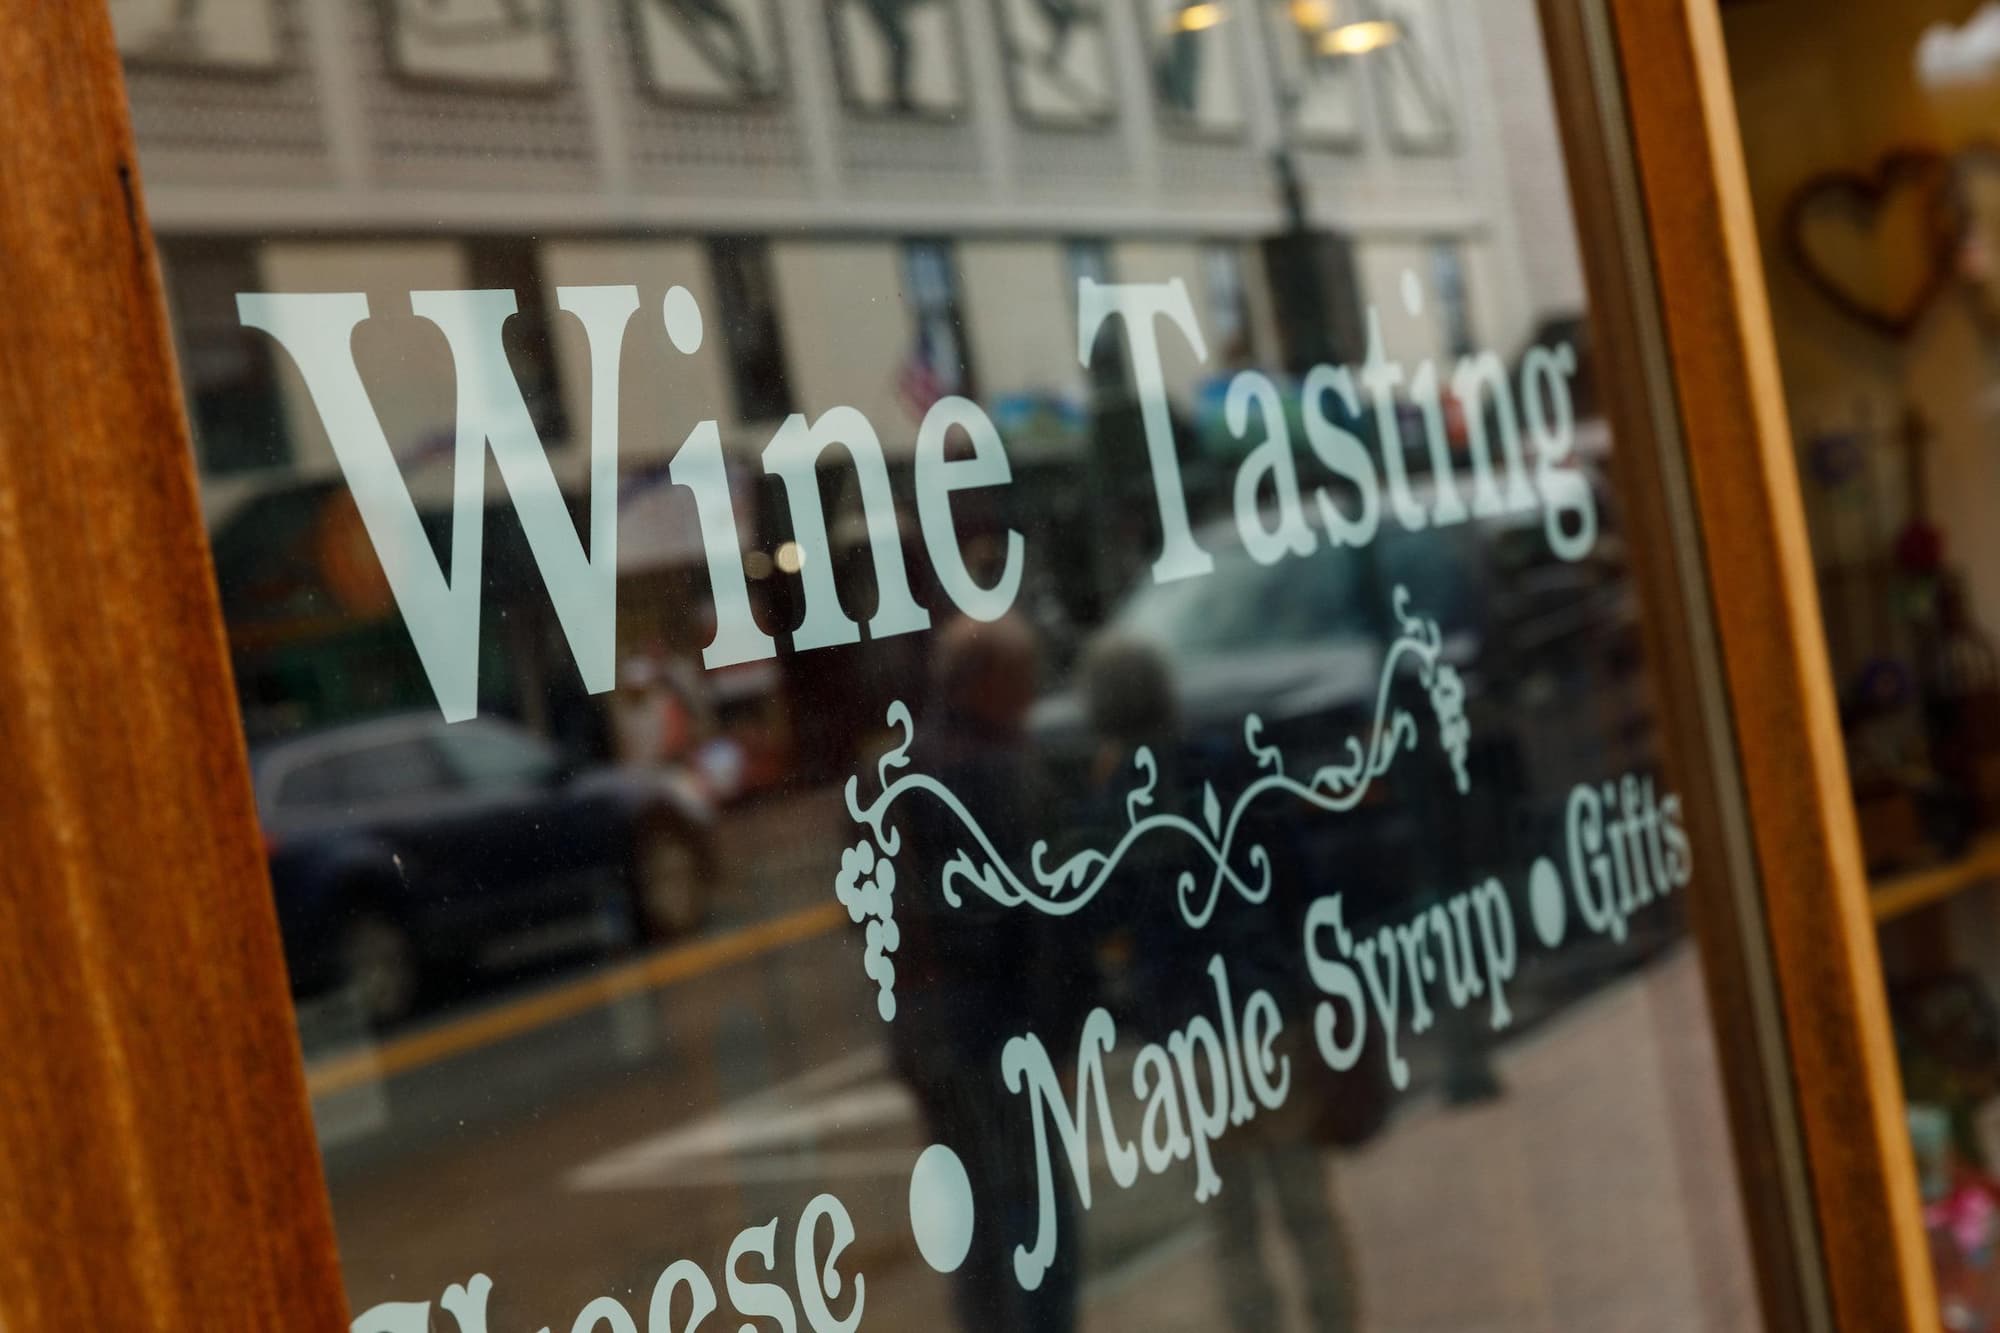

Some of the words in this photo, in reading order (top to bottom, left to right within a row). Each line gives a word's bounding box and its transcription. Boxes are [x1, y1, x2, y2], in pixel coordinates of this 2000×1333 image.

[235, 284, 1025, 724] Wine
[1077, 269, 1597, 583] Tasting
[1001, 953, 1291, 1291] Maple
[1303, 877, 1517, 1091] Syrup
[1565, 772, 1693, 944] Gifts
